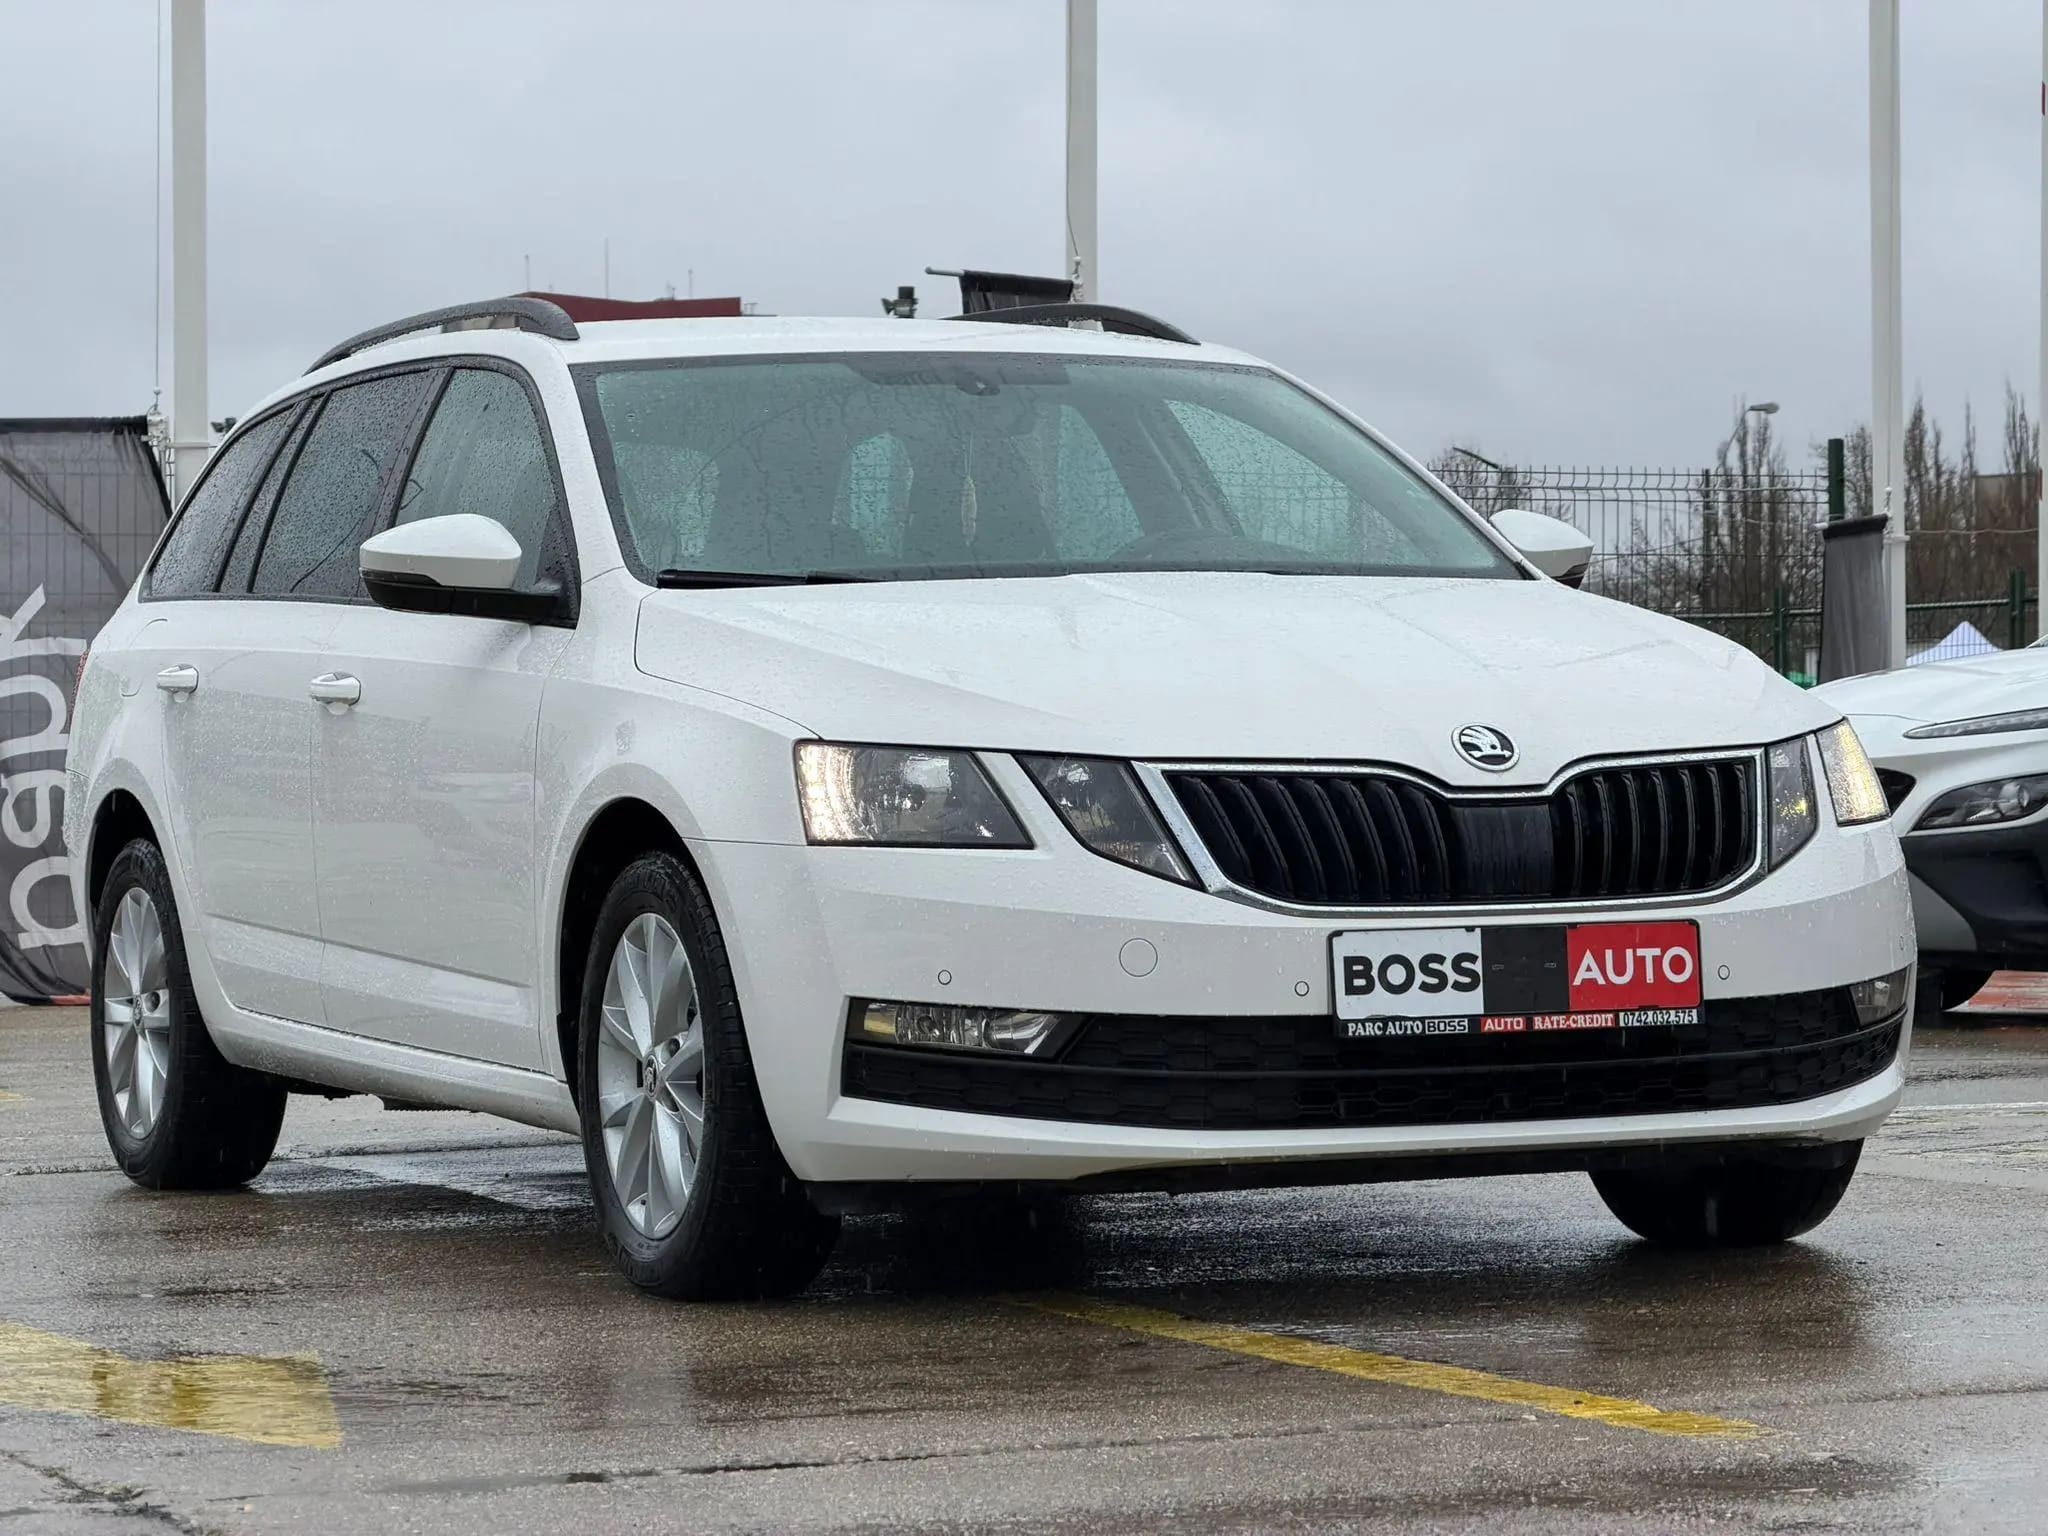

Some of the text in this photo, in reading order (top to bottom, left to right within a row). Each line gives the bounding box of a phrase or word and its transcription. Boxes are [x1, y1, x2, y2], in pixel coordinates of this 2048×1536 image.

[1343, 946, 1694, 996] BOSS AUTO
[1347, 1021, 1384, 1036] PARC
[1385, 1019, 1423, 1035] AUTO
[1426, 1019, 1468, 1033] BOSS
[1484, 1017, 1525, 1031] AUTO
[1533, 1013, 1614, 1030] RATE-CREDIT
